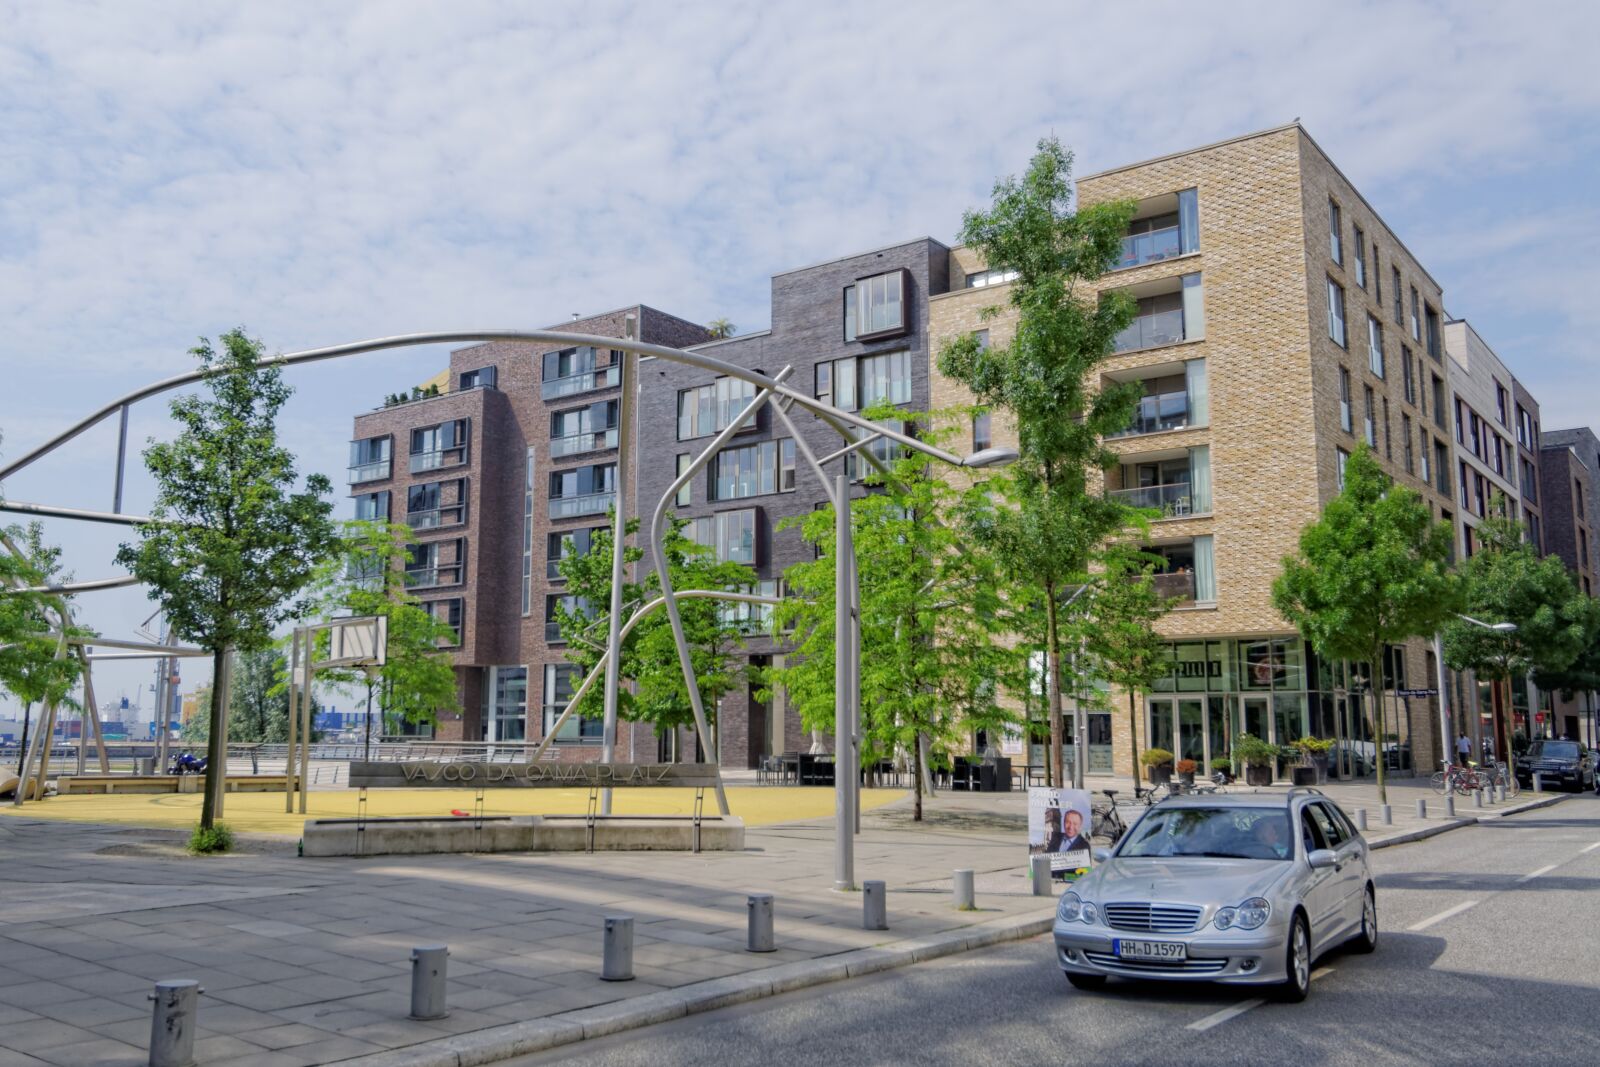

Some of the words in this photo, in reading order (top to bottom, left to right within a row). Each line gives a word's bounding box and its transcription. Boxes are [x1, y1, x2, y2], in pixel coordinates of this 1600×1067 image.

[401, 763, 476, 781] VASCO
[487, 764, 516, 781] DA
[526, 764, 588, 781] GAMA
[596, 764, 673, 781] PLATZ
